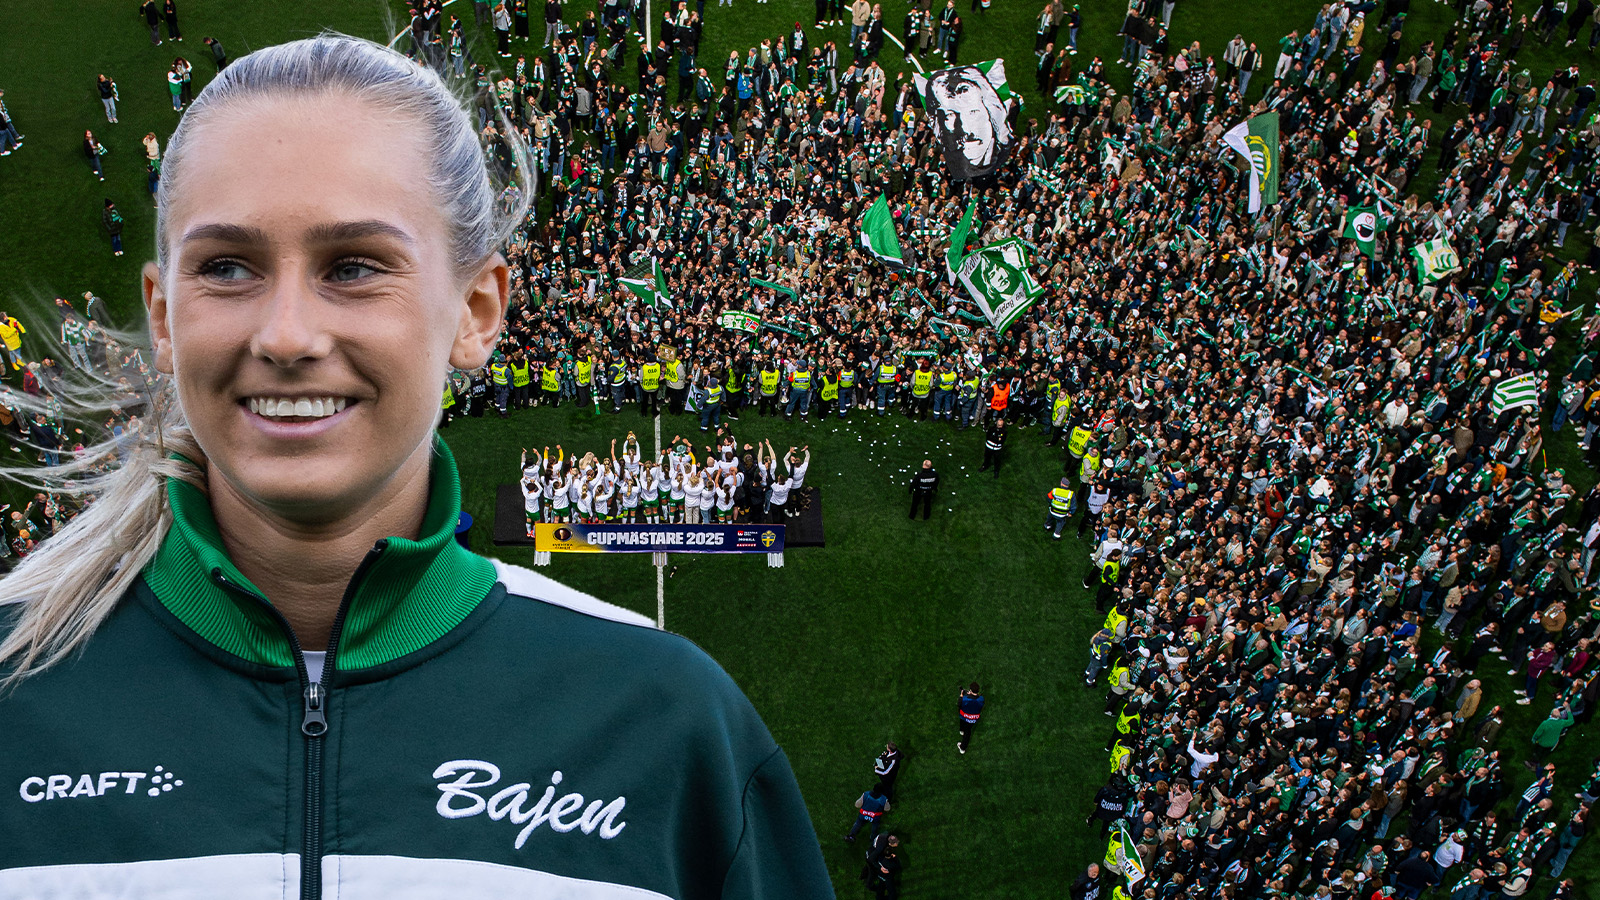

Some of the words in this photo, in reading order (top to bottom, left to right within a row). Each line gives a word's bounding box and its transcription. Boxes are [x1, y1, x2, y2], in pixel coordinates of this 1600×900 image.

[586, 531, 684, 545] CUPMÄSTARE
[686, 532, 725, 545] 2025
[19, 771, 147, 803] CRAFT
[433, 760, 627, 849] Bajen
